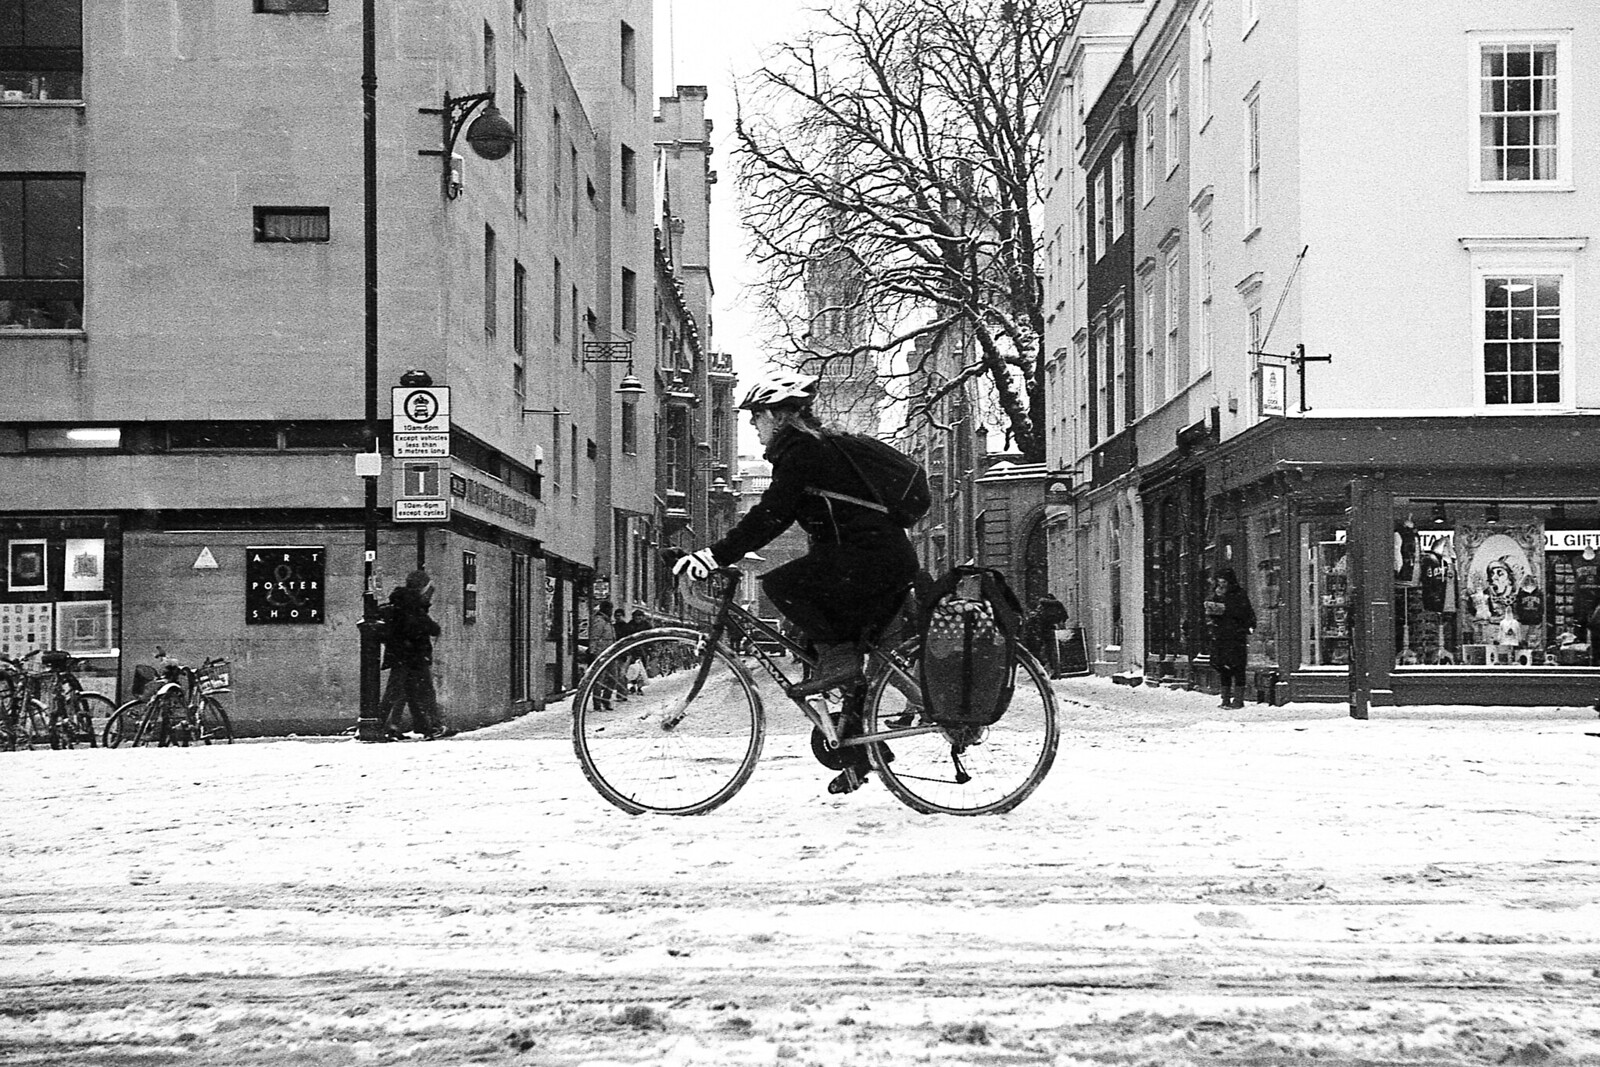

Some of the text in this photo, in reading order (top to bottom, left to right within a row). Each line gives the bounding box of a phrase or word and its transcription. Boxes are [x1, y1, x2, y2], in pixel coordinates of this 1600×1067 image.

[253, 553, 318, 562] ART
[252, 581, 318, 590] POSTER
[252, 609, 318, 618] SHOP
